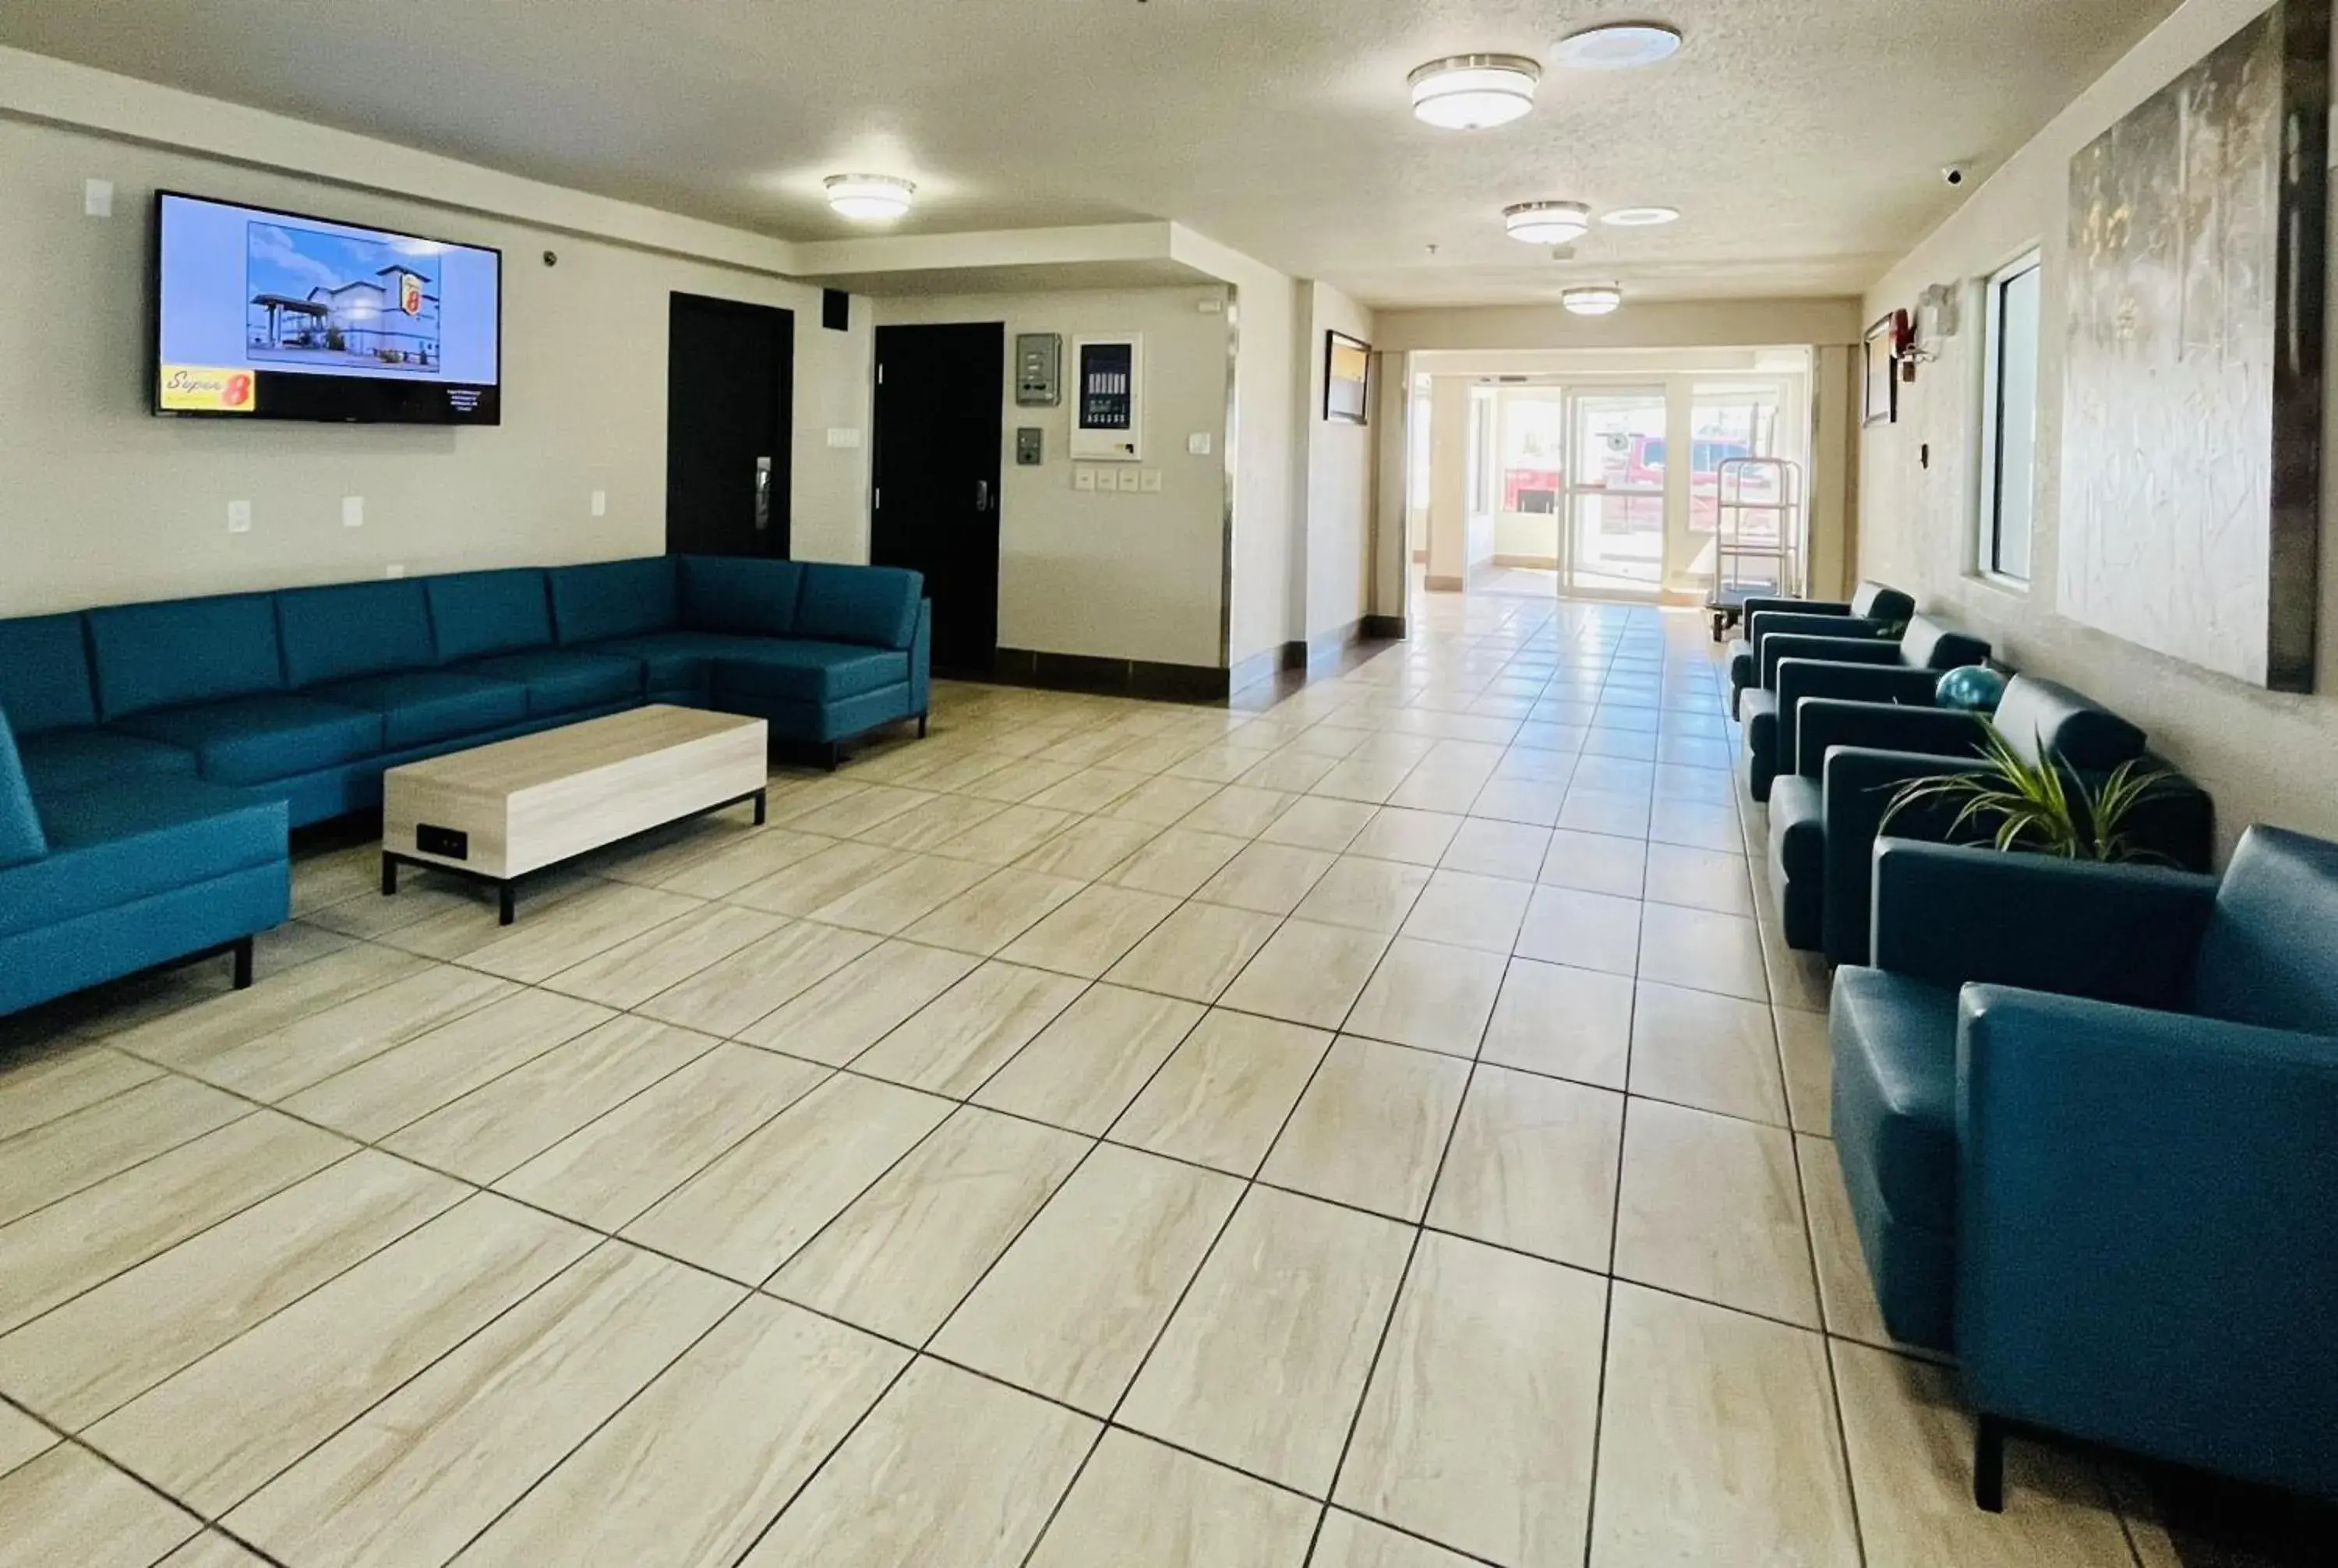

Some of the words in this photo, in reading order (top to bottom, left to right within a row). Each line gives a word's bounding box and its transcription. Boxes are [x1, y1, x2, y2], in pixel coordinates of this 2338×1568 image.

[407, 291, 419, 312] 8
[167, 370, 223, 393] Super
[221, 373, 250, 404] 8
